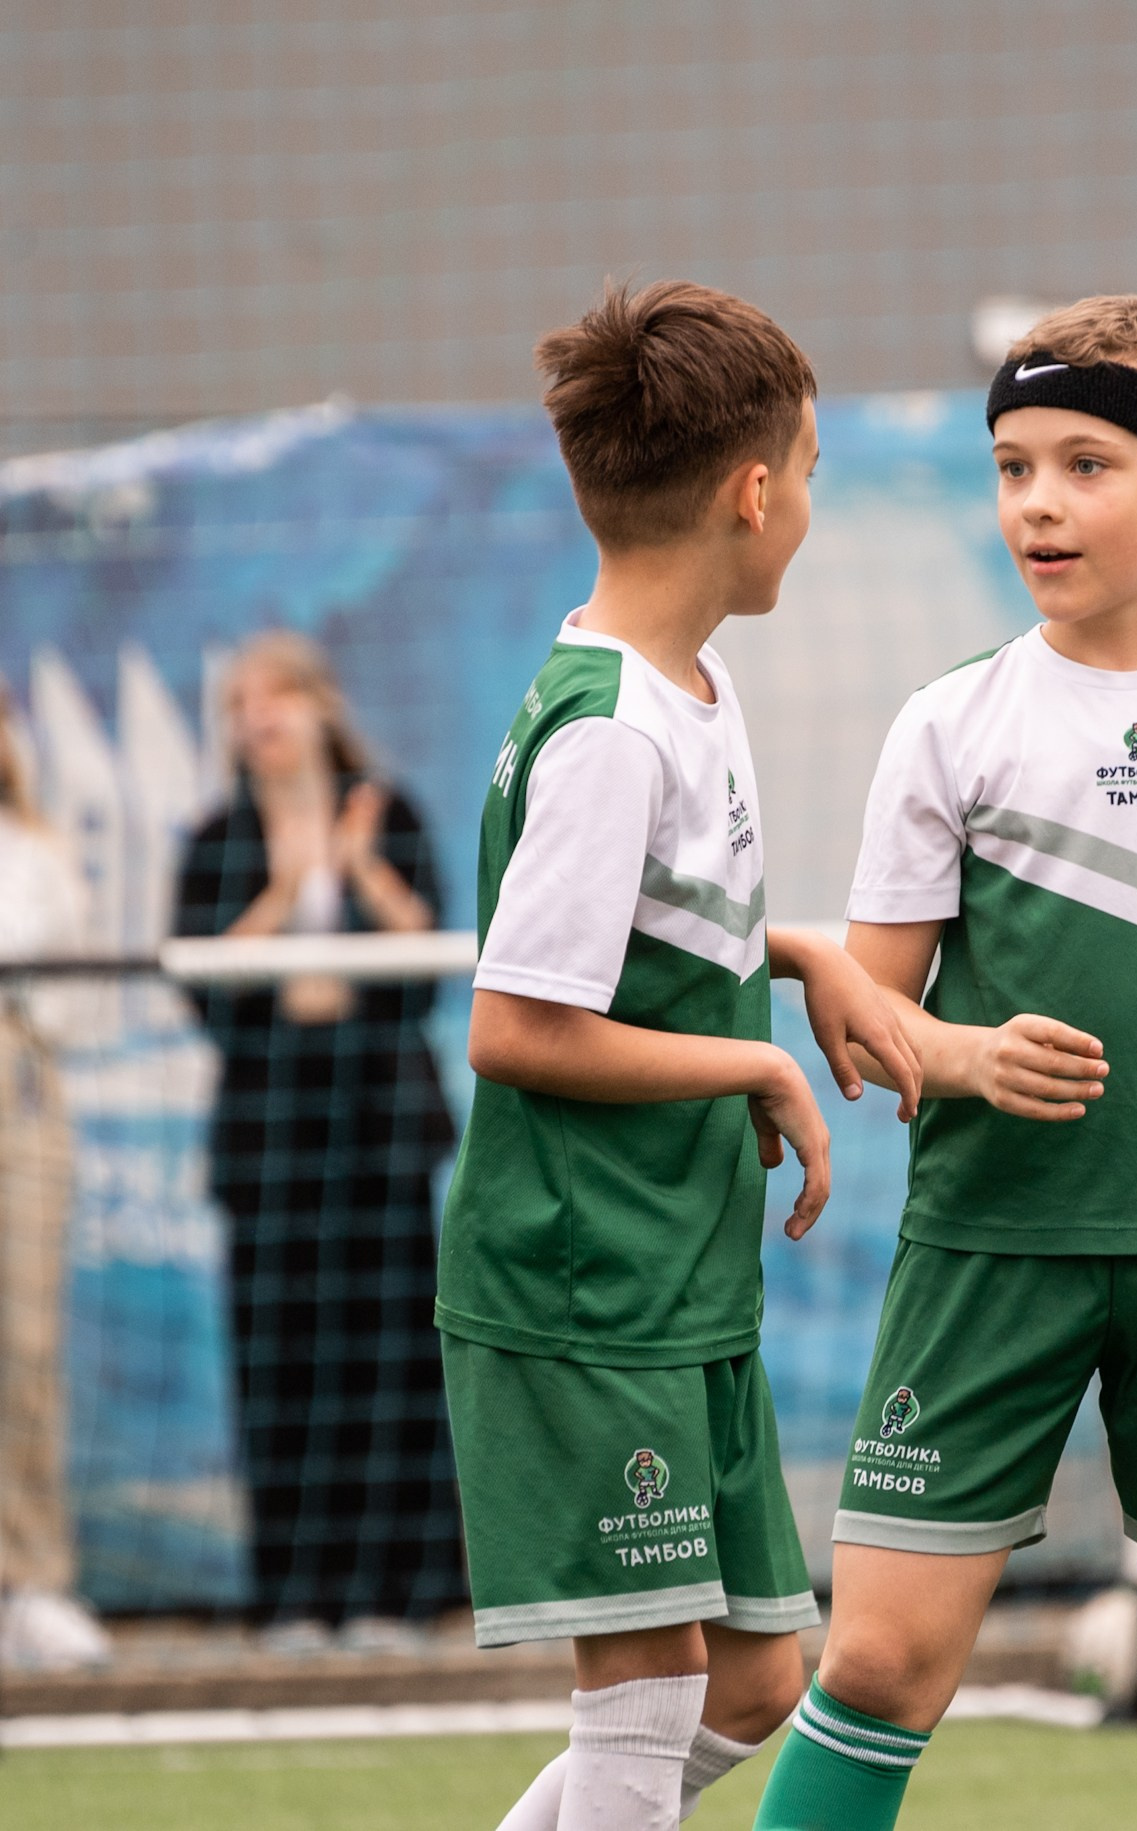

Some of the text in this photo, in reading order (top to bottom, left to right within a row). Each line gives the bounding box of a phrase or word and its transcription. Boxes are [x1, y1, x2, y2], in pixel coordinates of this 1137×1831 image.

[854, 1438, 942, 1464] ФУТБОЛИКА
[853, 1468, 926, 1495] ТАМБОВ
[598, 1504, 710, 1533] ФУТБОЛИКА
[631, 1528, 669, 1539] ФУТБОЛА
[615, 1537, 708, 1567] ТАМБОВ
